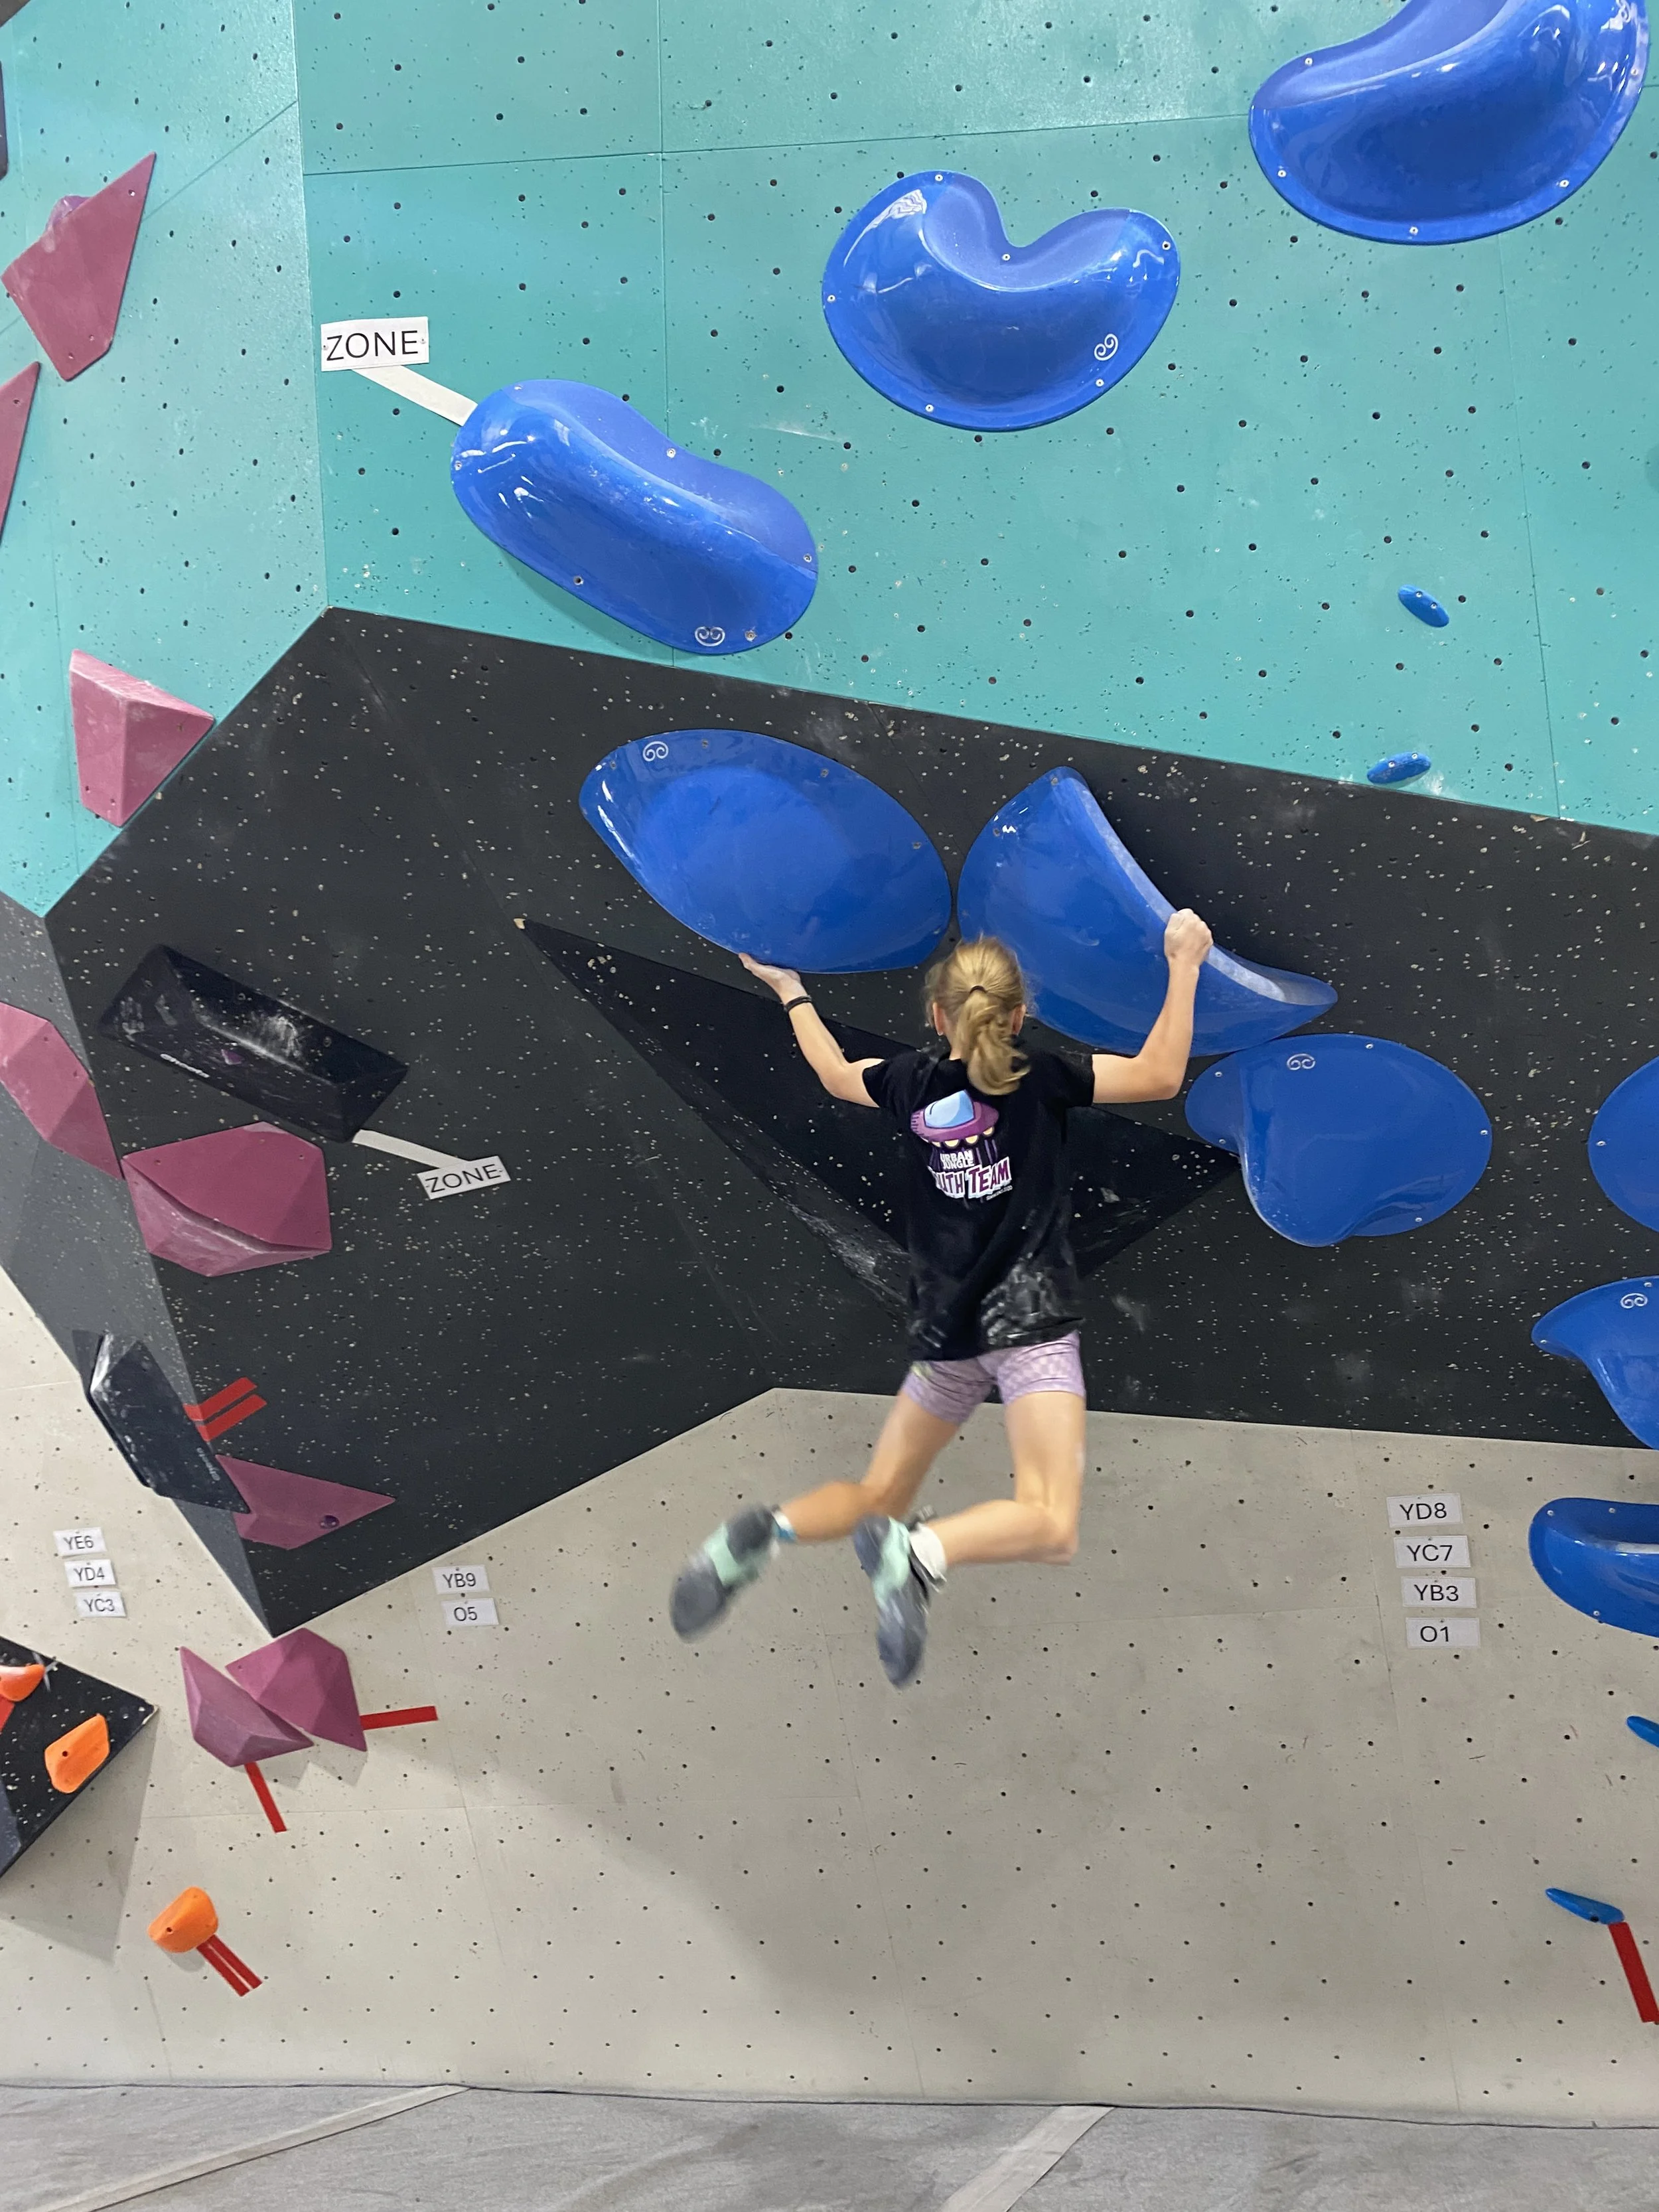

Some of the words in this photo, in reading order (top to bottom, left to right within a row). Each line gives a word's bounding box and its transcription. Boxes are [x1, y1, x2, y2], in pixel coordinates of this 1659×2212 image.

[326, 330, 419, 361] ZONE
[940, 1149, 974, 1163] URBAN
[943, 1159, 975, 1170] JUNGLE
[425, 1163, 502, 1193] ZONE
[965, 1156, 1012, 1199] TEAM
[1400, 1502, 1447, 1520] YD8
[63, 1535, 94, 1550] YE6
[1406, 1544, 1453, 1562] YC7
[73, 1567, 105, 1582] YD4
[442, 1572, 476, 1588] YB9
[1413, 1584, 1459, 1601] YB3
[84, 1598, 115, 1612] YC3
